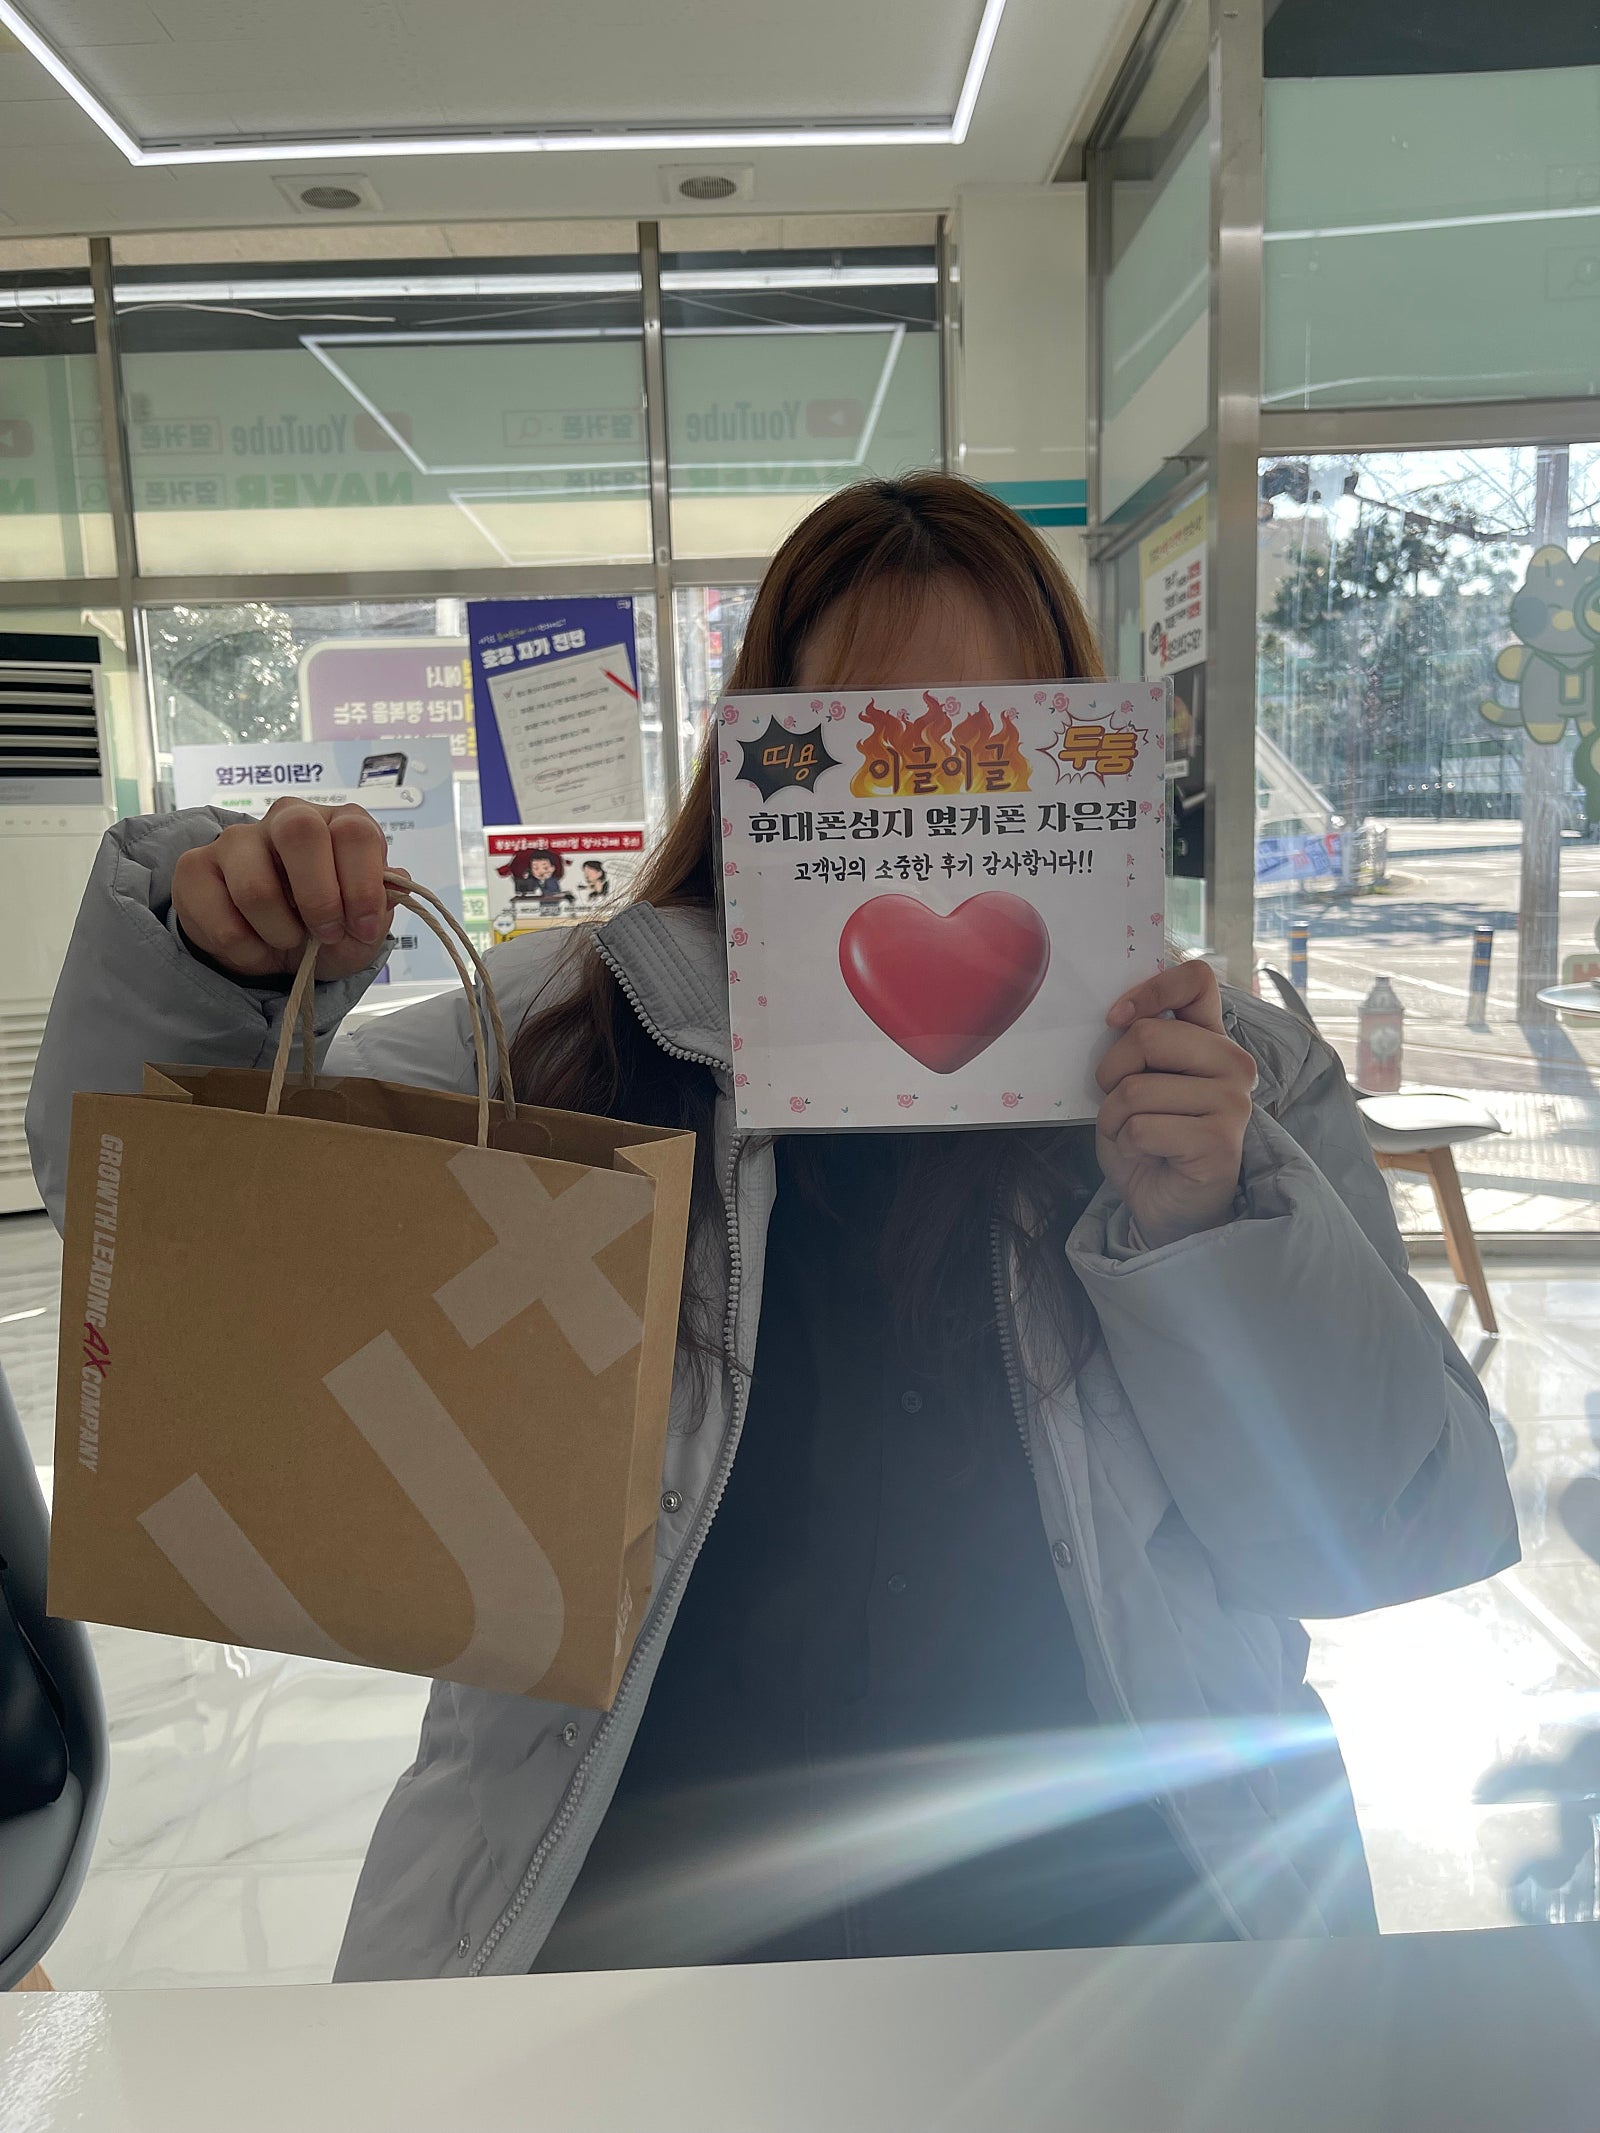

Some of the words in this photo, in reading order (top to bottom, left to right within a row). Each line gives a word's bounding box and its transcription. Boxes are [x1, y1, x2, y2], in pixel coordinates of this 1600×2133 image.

[216, 764, 323, 785] 옆커폰이란?
[762, 743, 819, 781] 띠용
[869, 743, 1012, 795] 이글이글
[1058, 725, 1139, 776] 두둥
[748, 807, 914, 843] 휴대폰성지
[926, 803, 1027, 838] 옆커폰
[1037, 799, 1137, 833] 자은점
[794, 855, 866, 884] 고객님의
[874, 853, 934, 882] 소중한
[940, 851, 973, 879] 후기
[982, 848, 1093, 877] 감사합니다!!
[95, 1132, 123, 1231] GROWTH
[84, 1230, 117, 1328] LEADING
[82, 1321, 112, 1378] AX
[78, 1366, 102, 1473] COMPANY
